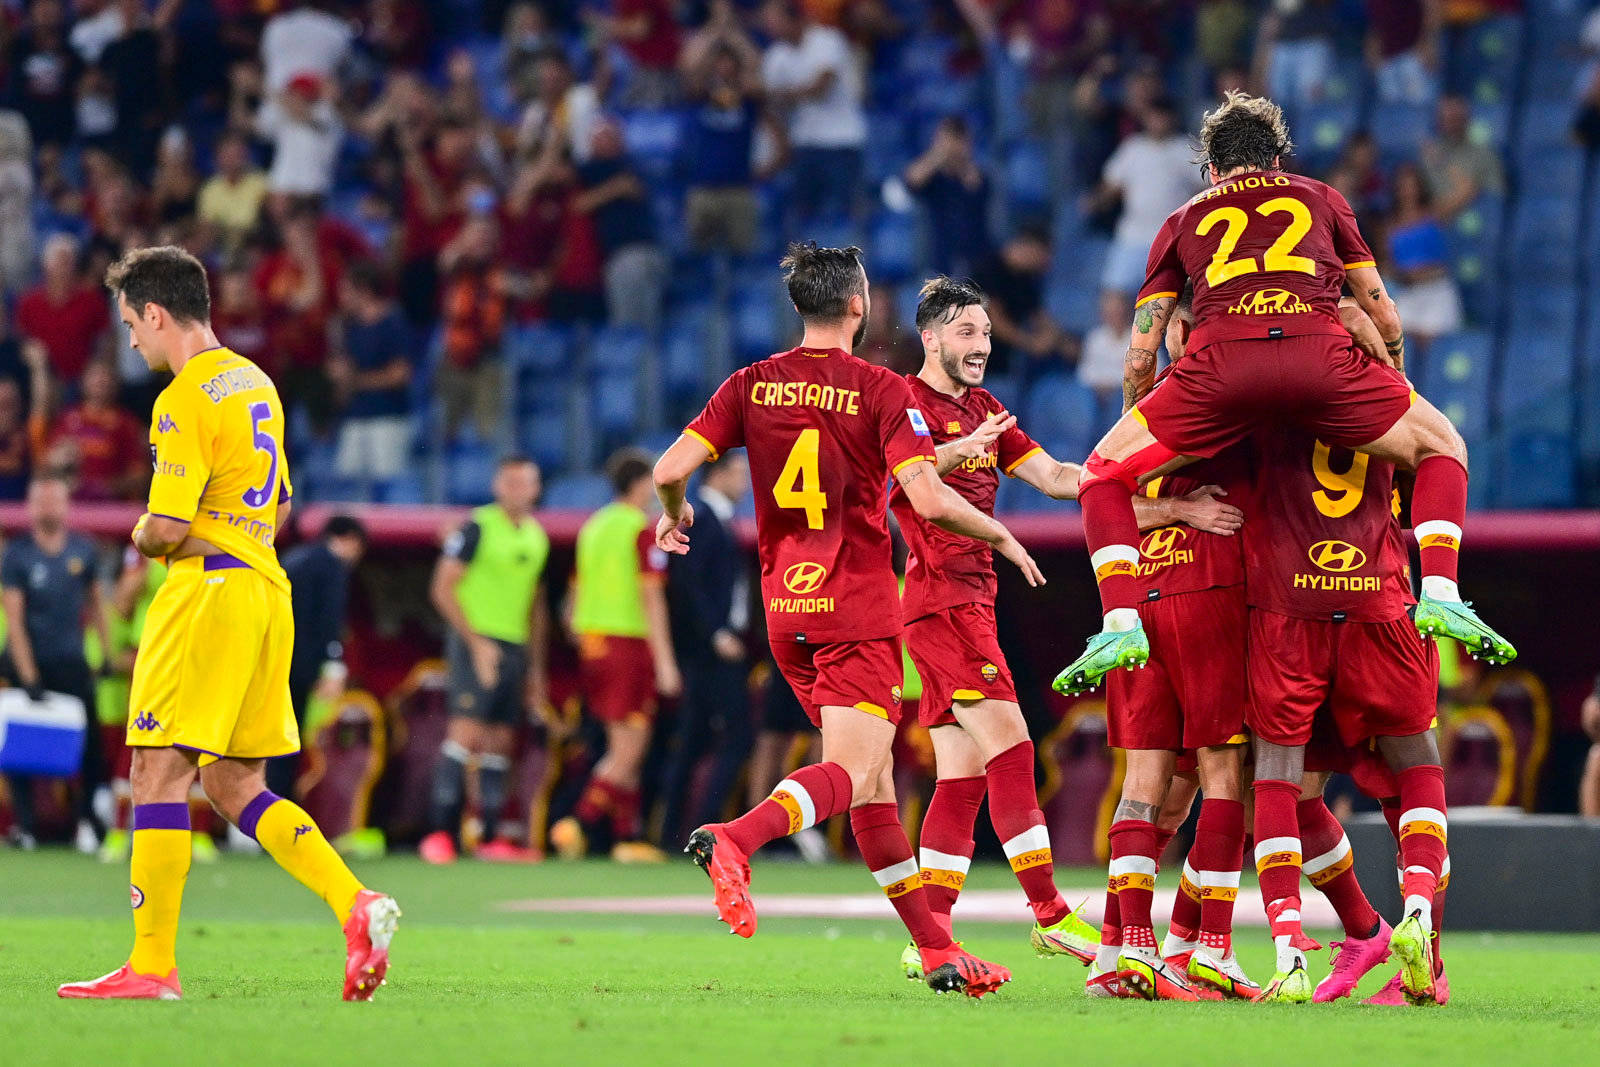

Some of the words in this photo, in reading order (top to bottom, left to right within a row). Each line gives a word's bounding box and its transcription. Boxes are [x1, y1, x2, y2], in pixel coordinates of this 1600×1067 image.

[1195, 197, 1316, 288] 22
[751, 381, 860, 416] CRISTANTE
[242, 401, 277, 509] 5
[772, 428, 828, 530] 4
[1312, 438, 1369, 518] 9
[769, 597, 836, 614] HYUNDAI
[1293, 573, 1381, 592] HYUNDAI
